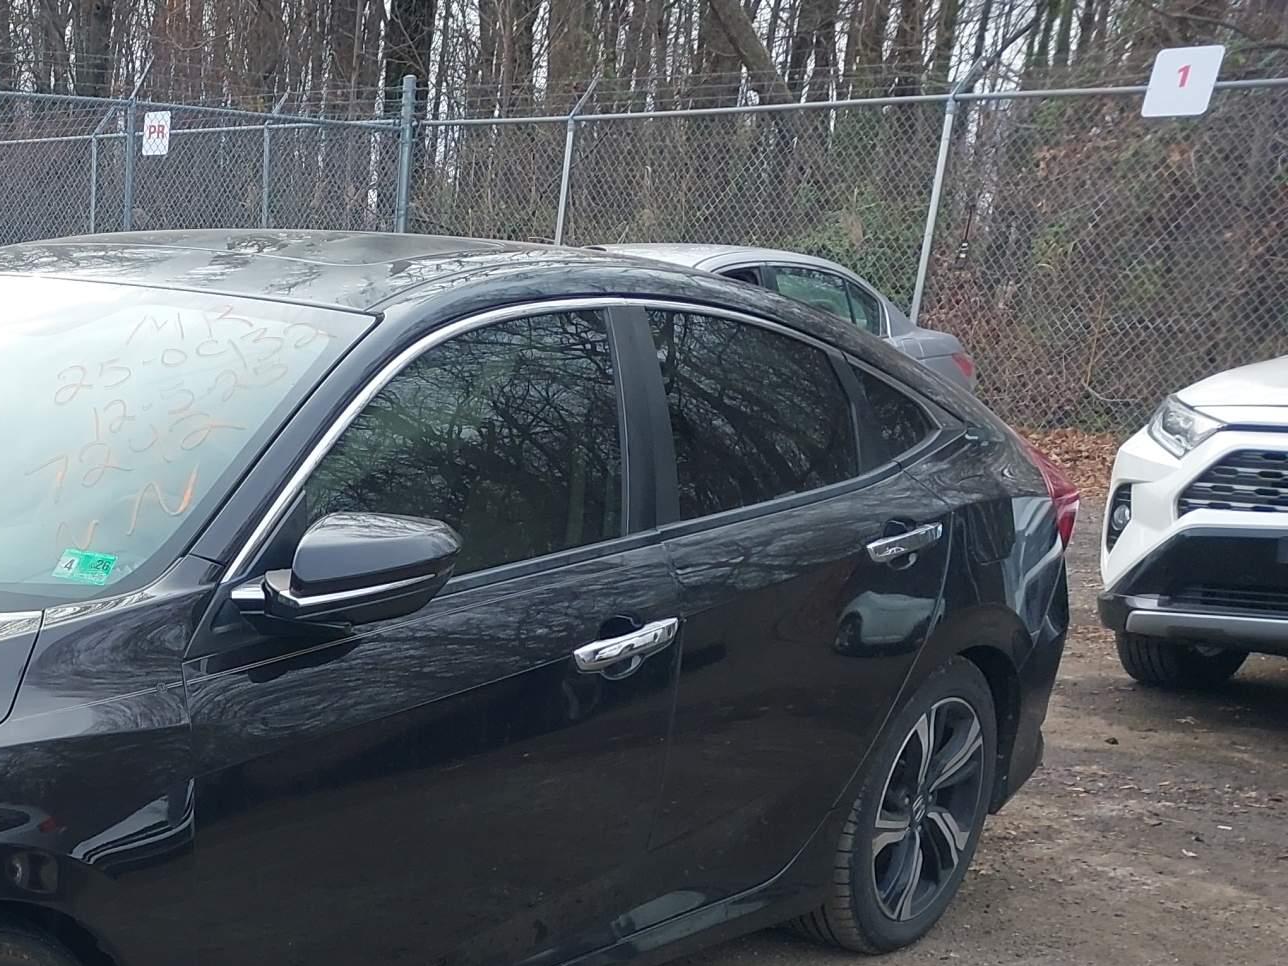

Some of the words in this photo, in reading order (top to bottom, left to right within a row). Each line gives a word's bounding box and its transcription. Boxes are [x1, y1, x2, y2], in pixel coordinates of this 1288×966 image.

[1178, 64, 1192, 88] 1
[148, 124, 166, 140] PR
[63, 558, 75, 571] 4
